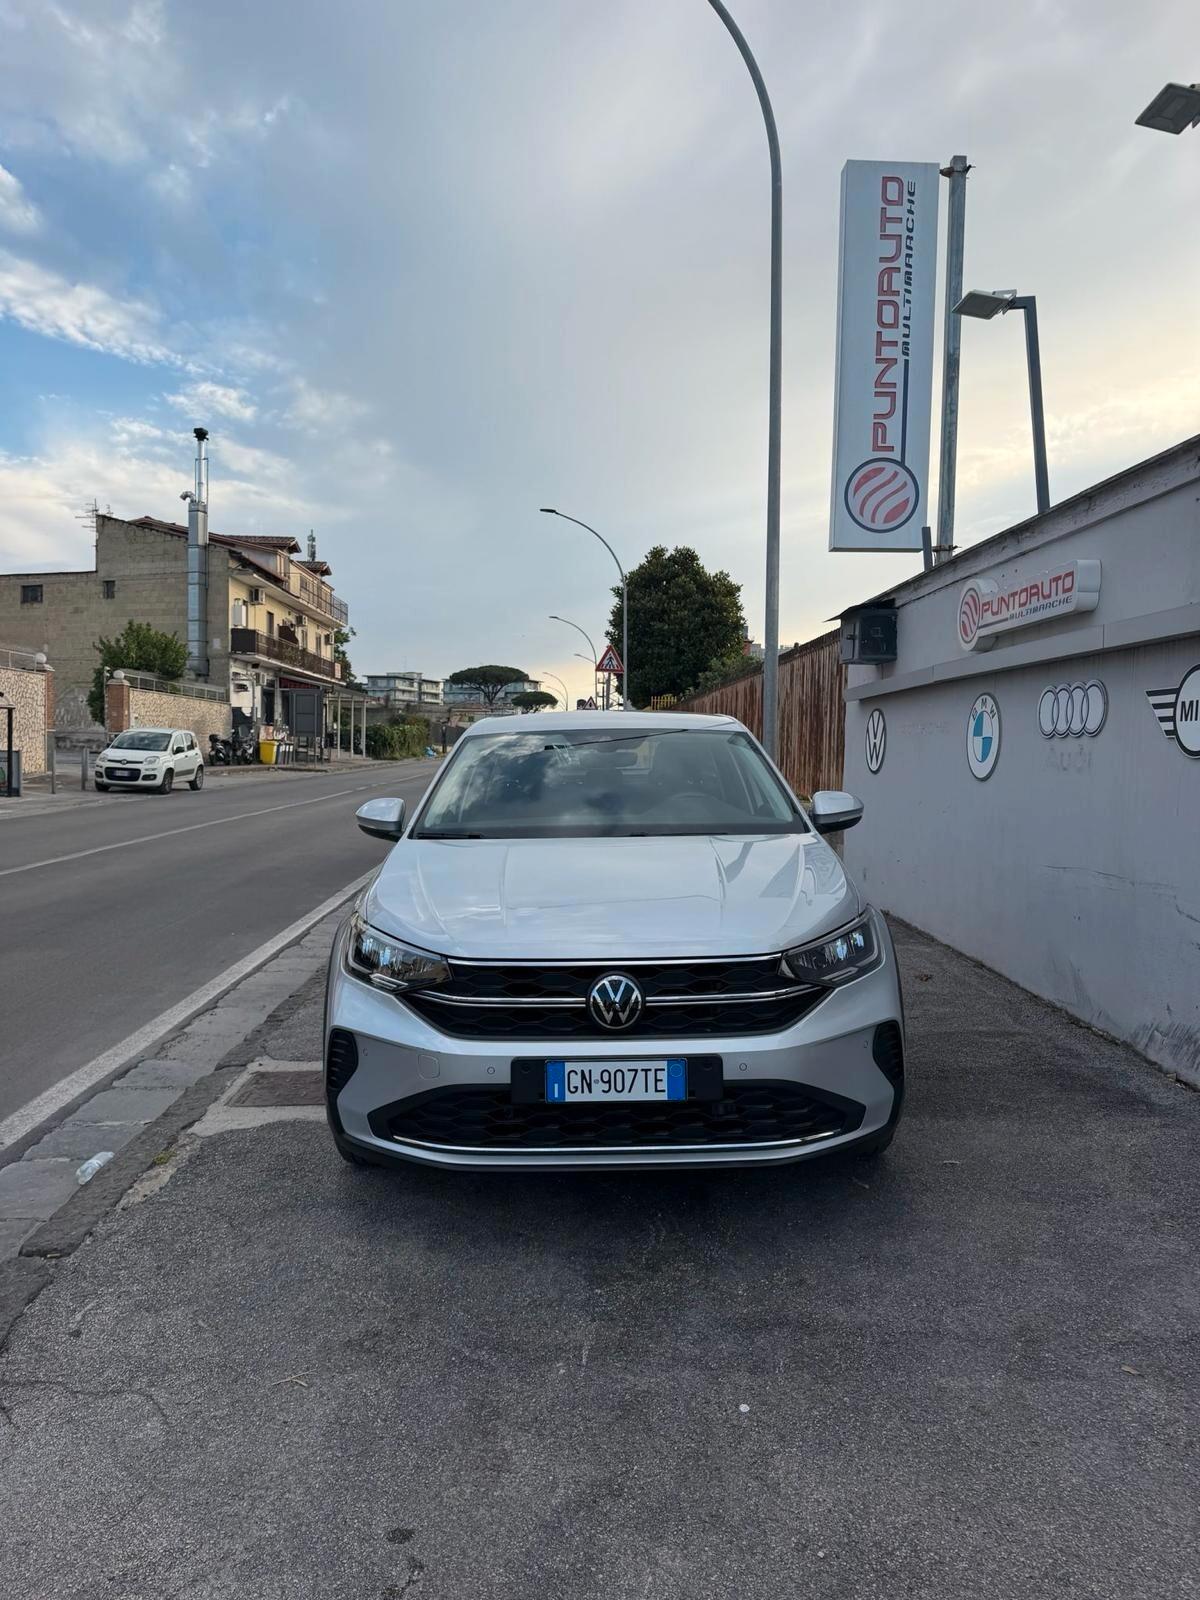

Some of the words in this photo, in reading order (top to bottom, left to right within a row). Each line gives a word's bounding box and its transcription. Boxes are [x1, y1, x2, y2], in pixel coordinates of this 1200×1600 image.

[901, 181, 917, 356] MULTIMARCHE
[872, 176, 904, 452] PUNTOAUTO
[981, 570, 1075, 620] PUNTOAUTO
[1009, 595, 1073, 620] MULTIMARCHE
[971, 697, 997, 721] BMW
